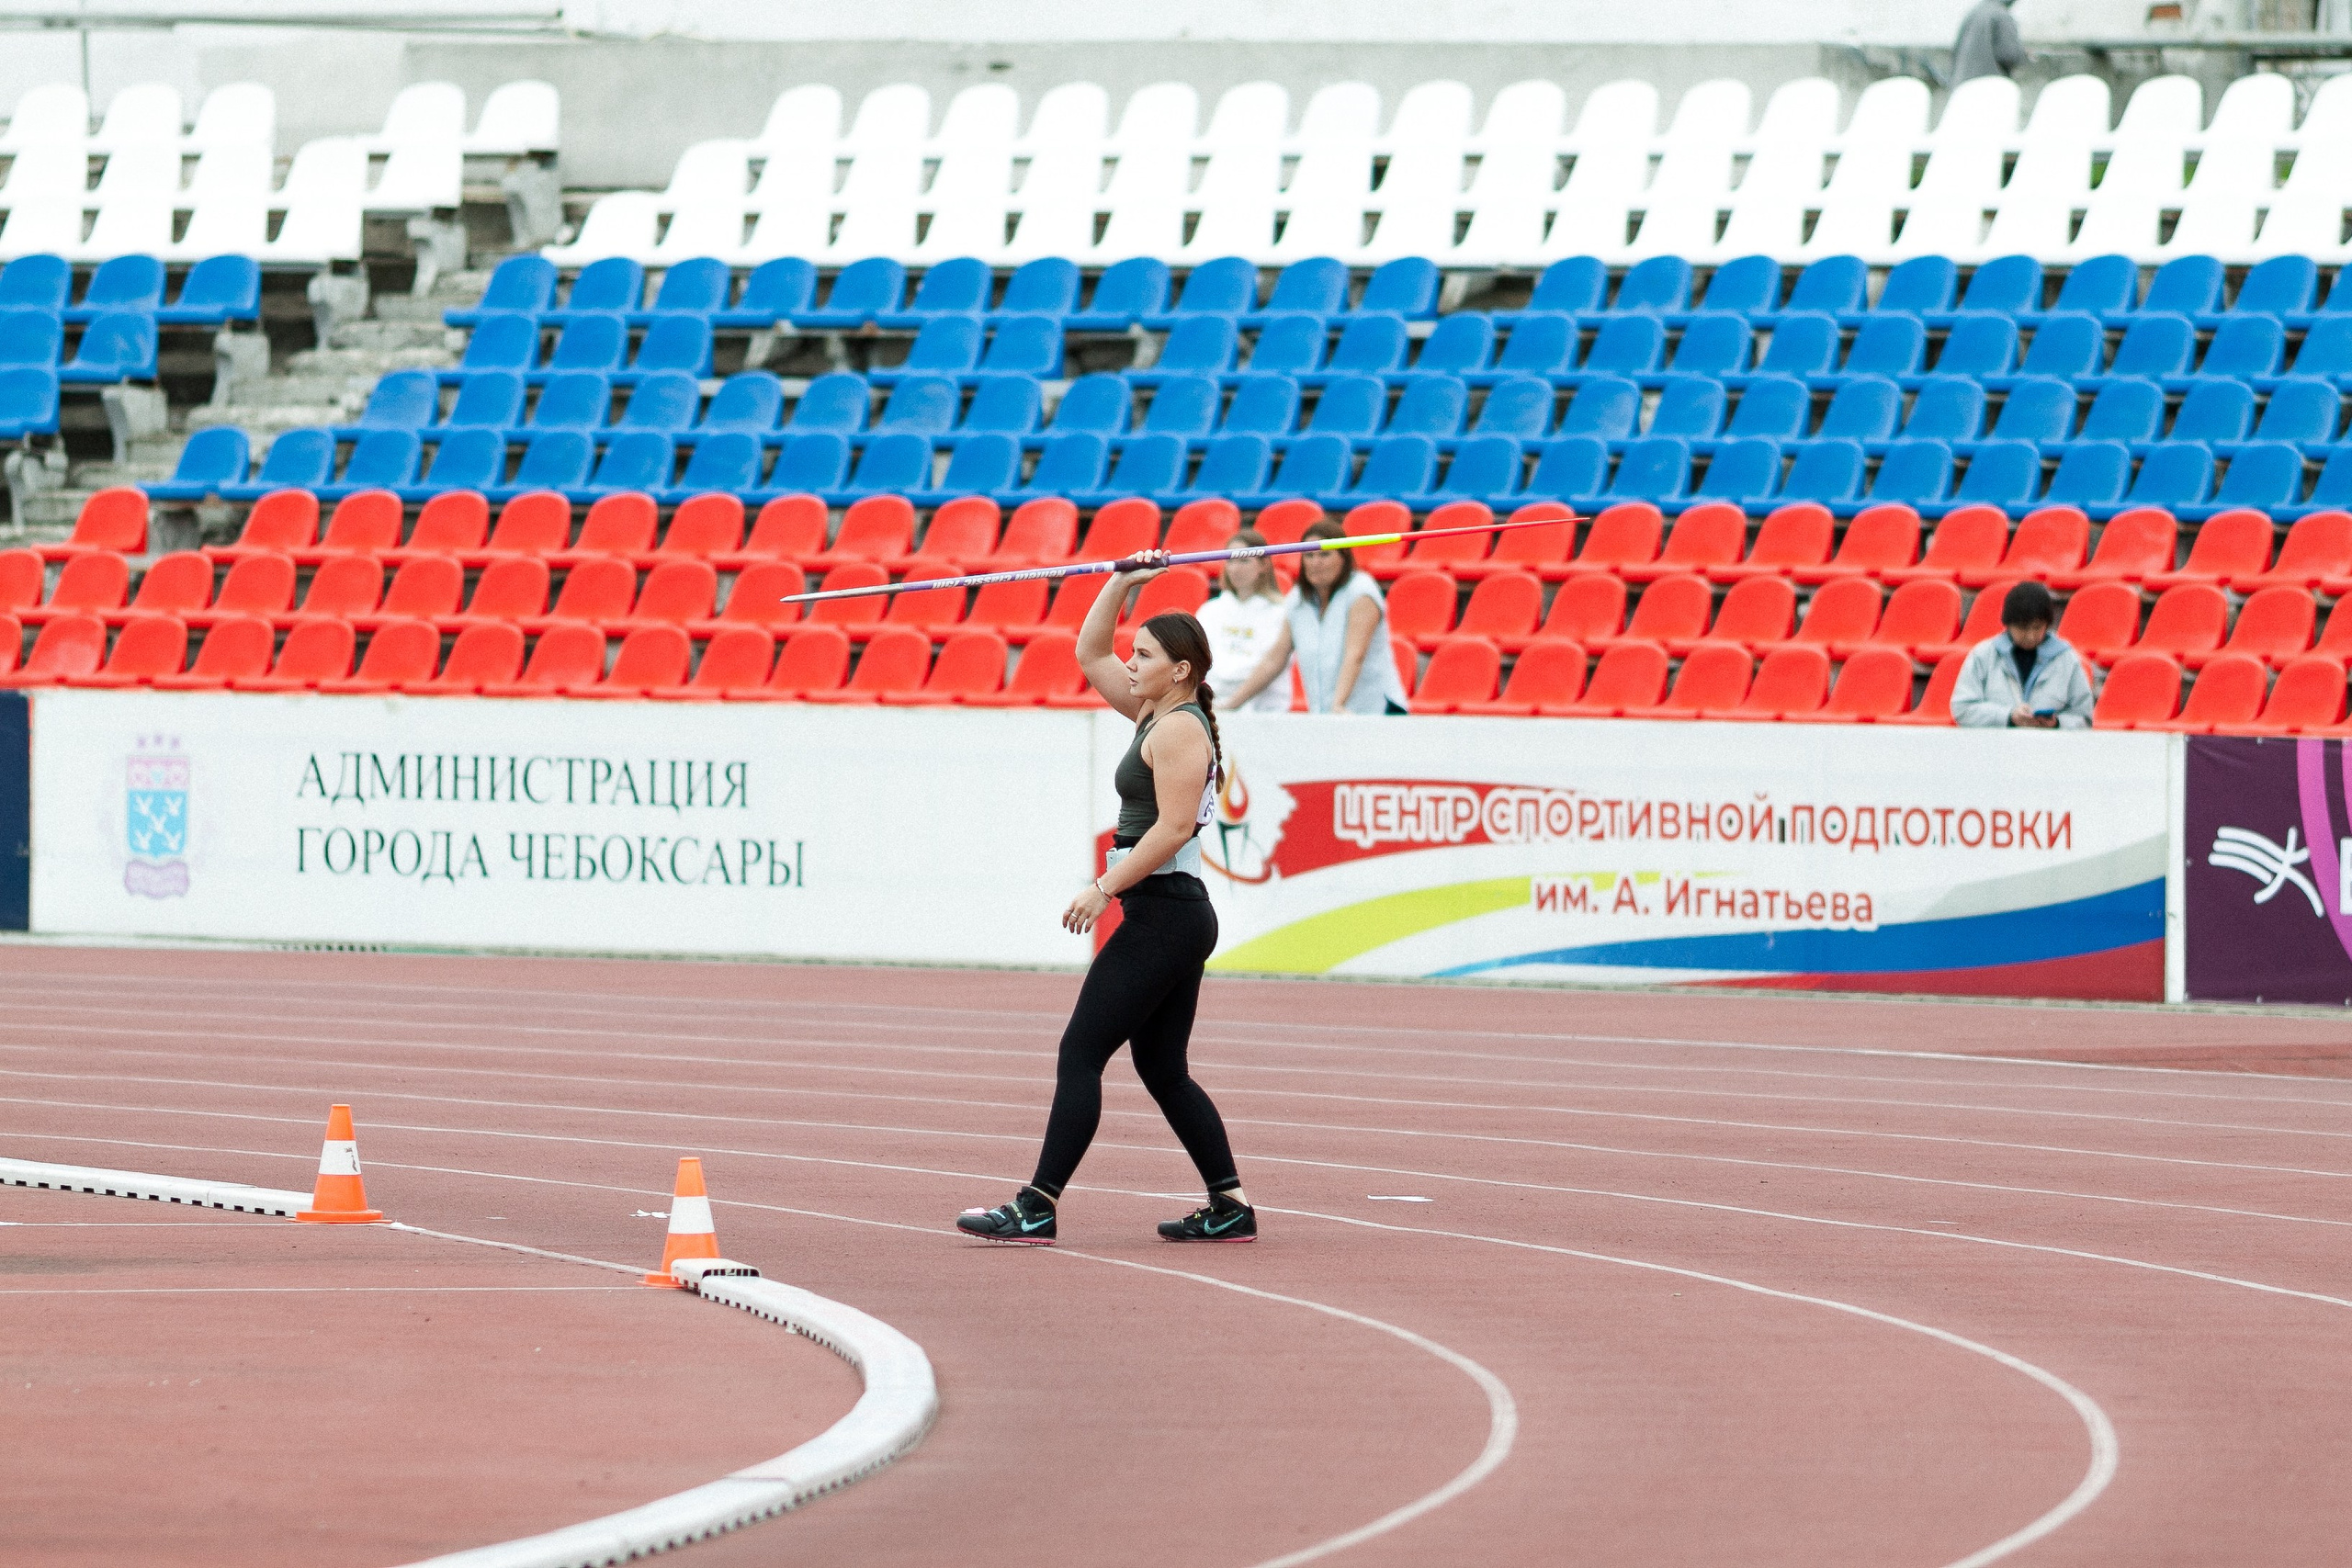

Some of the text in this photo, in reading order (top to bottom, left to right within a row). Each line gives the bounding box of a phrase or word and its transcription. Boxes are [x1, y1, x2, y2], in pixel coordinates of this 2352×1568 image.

[298, 752, 748, 813] АДМИНИСТРАЦИЯ
[1339, 790, 2073, 852] ЦЕНТР СПОРТИВНОЙ ПОДГОТОВКИ
[298, 827, 806, 888] ГОРОДА ЧЕБОКСАРЫ
[1535, 878, 1875, 923] им. А. Игнатьева
